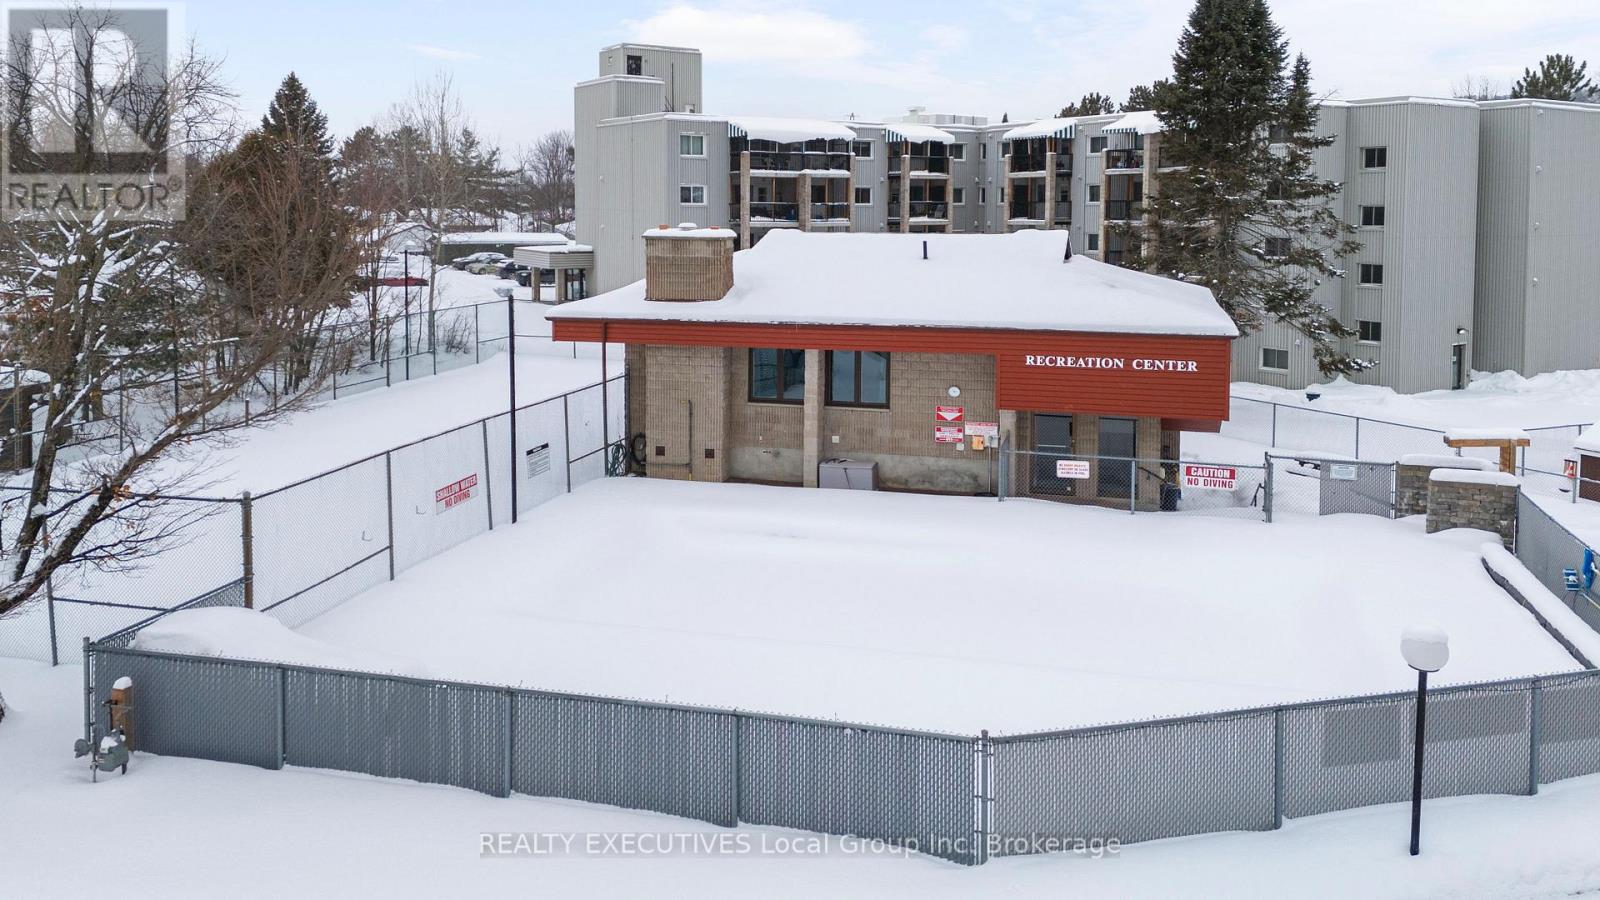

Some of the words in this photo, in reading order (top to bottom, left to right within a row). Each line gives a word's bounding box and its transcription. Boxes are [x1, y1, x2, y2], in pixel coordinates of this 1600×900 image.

[1025, 355, 1124, 369] RECREATION
[1132, 359, 1198, 372] CENTER
[1191, 467, 1231, 478] CAUTION
[1187, 477, 1199, 486] NO
[1203, 478, 1233, 489] DIVING
[445, 497, 452, 508] NO
